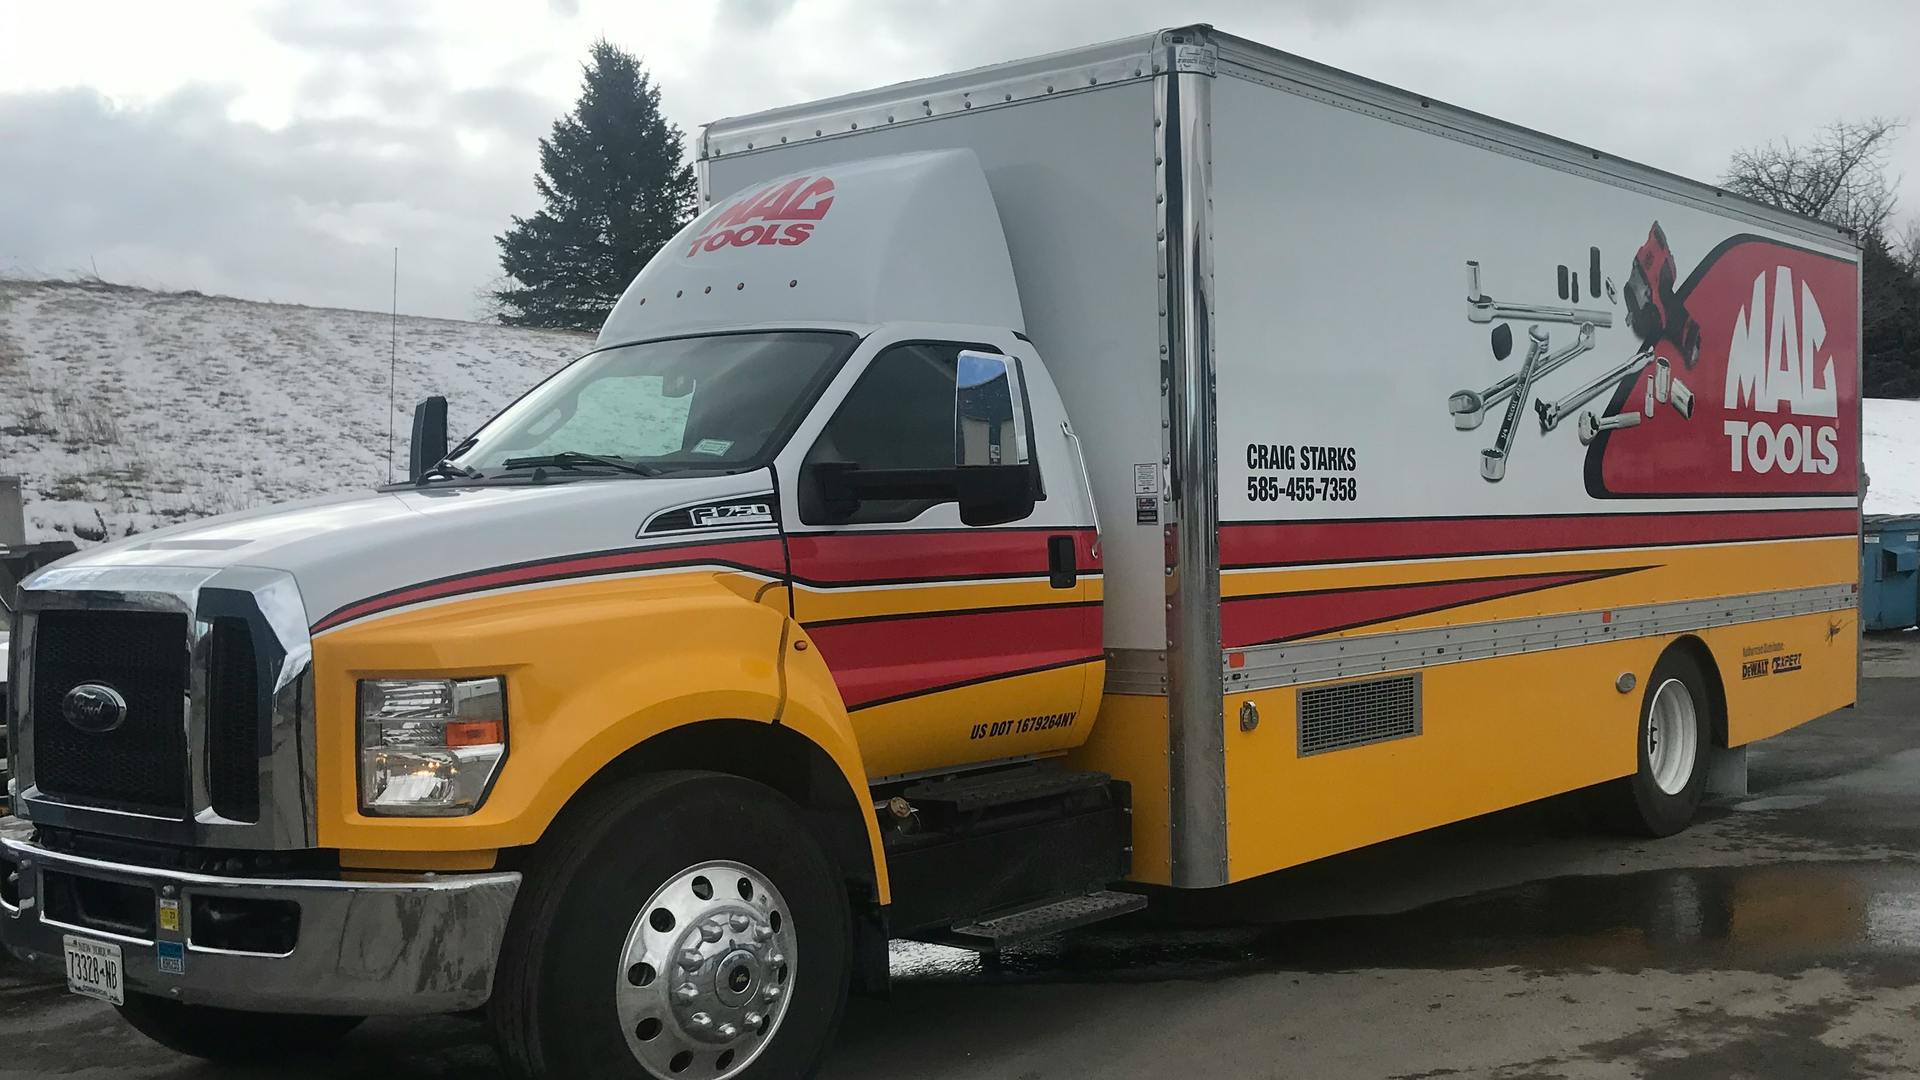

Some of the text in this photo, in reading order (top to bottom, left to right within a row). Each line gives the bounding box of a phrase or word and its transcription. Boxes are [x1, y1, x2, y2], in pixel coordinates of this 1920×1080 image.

[701, 176, 834, 234] MAC
[687, 223, 815, 258] TOOLS
[1724, 265, 1838, 418] MAC
[1246, 444, 1357, 471] CRAIG STARKS
[1724, 420, 1838, 475] TOOLS
[1247, 476, 1357, 502] 585-455-7358
[970, 712, 1077, 740] US DOT 1679264NY
